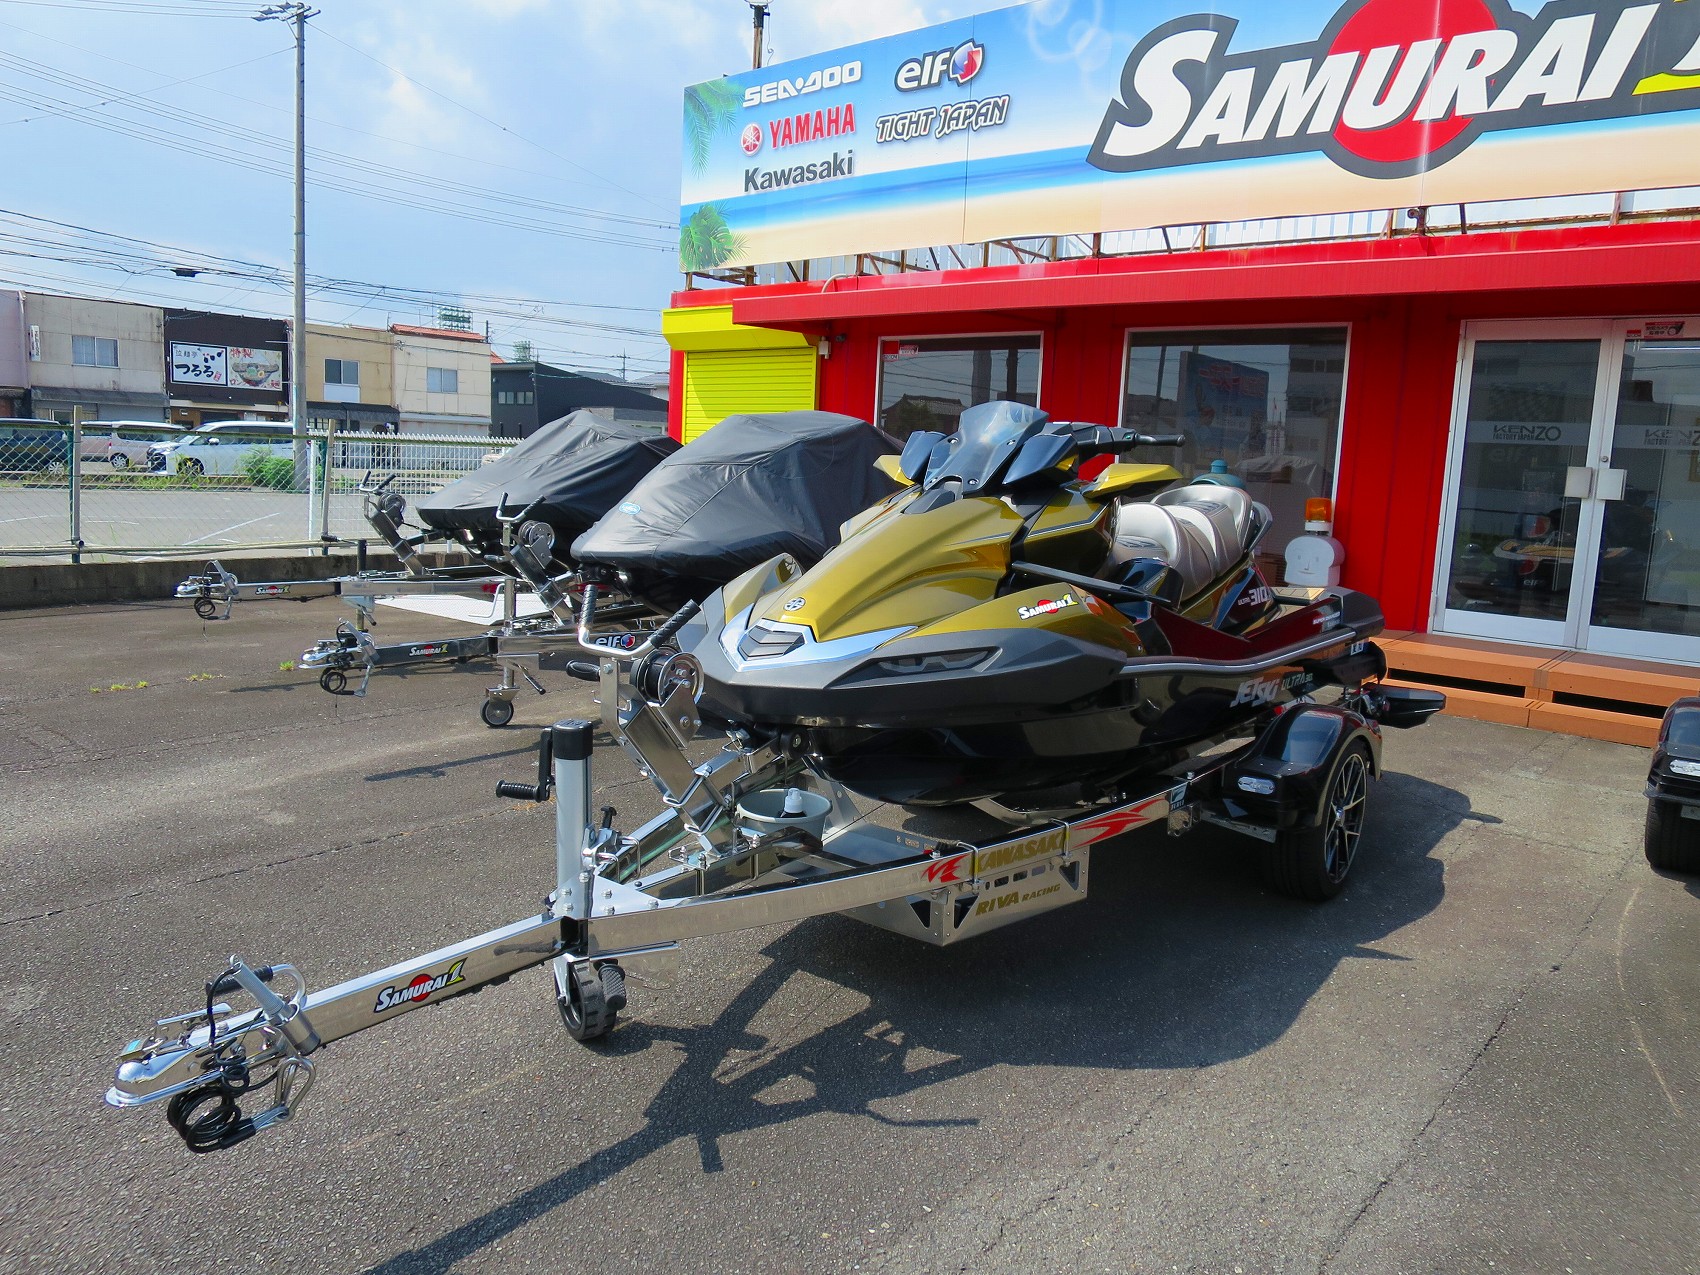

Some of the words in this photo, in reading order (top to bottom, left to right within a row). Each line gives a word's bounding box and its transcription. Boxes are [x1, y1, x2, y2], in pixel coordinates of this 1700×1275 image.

[898, 51, 948, 90] elf
[1103, 3, 1660, 156] SAMURAI
[769, 103, 856, 149] YAMAHA
[876, 107, 937, 144] TIGHT
[936, 95, 1011, 138] JAPAN
[744, 150, 853, 191] Kawasaki
[174, 364, 214, 378] つるる
[1493, 425, 1561, 441] KENZO
[1018, 599, 1067, 620] SAMURAI
[595, 635, 621, 648] elf
[975, 891, 1020, 916] RIVA
[1021, 883, 1061, 902] RACING
[375, 974, 449, 1012] SAMURAI
